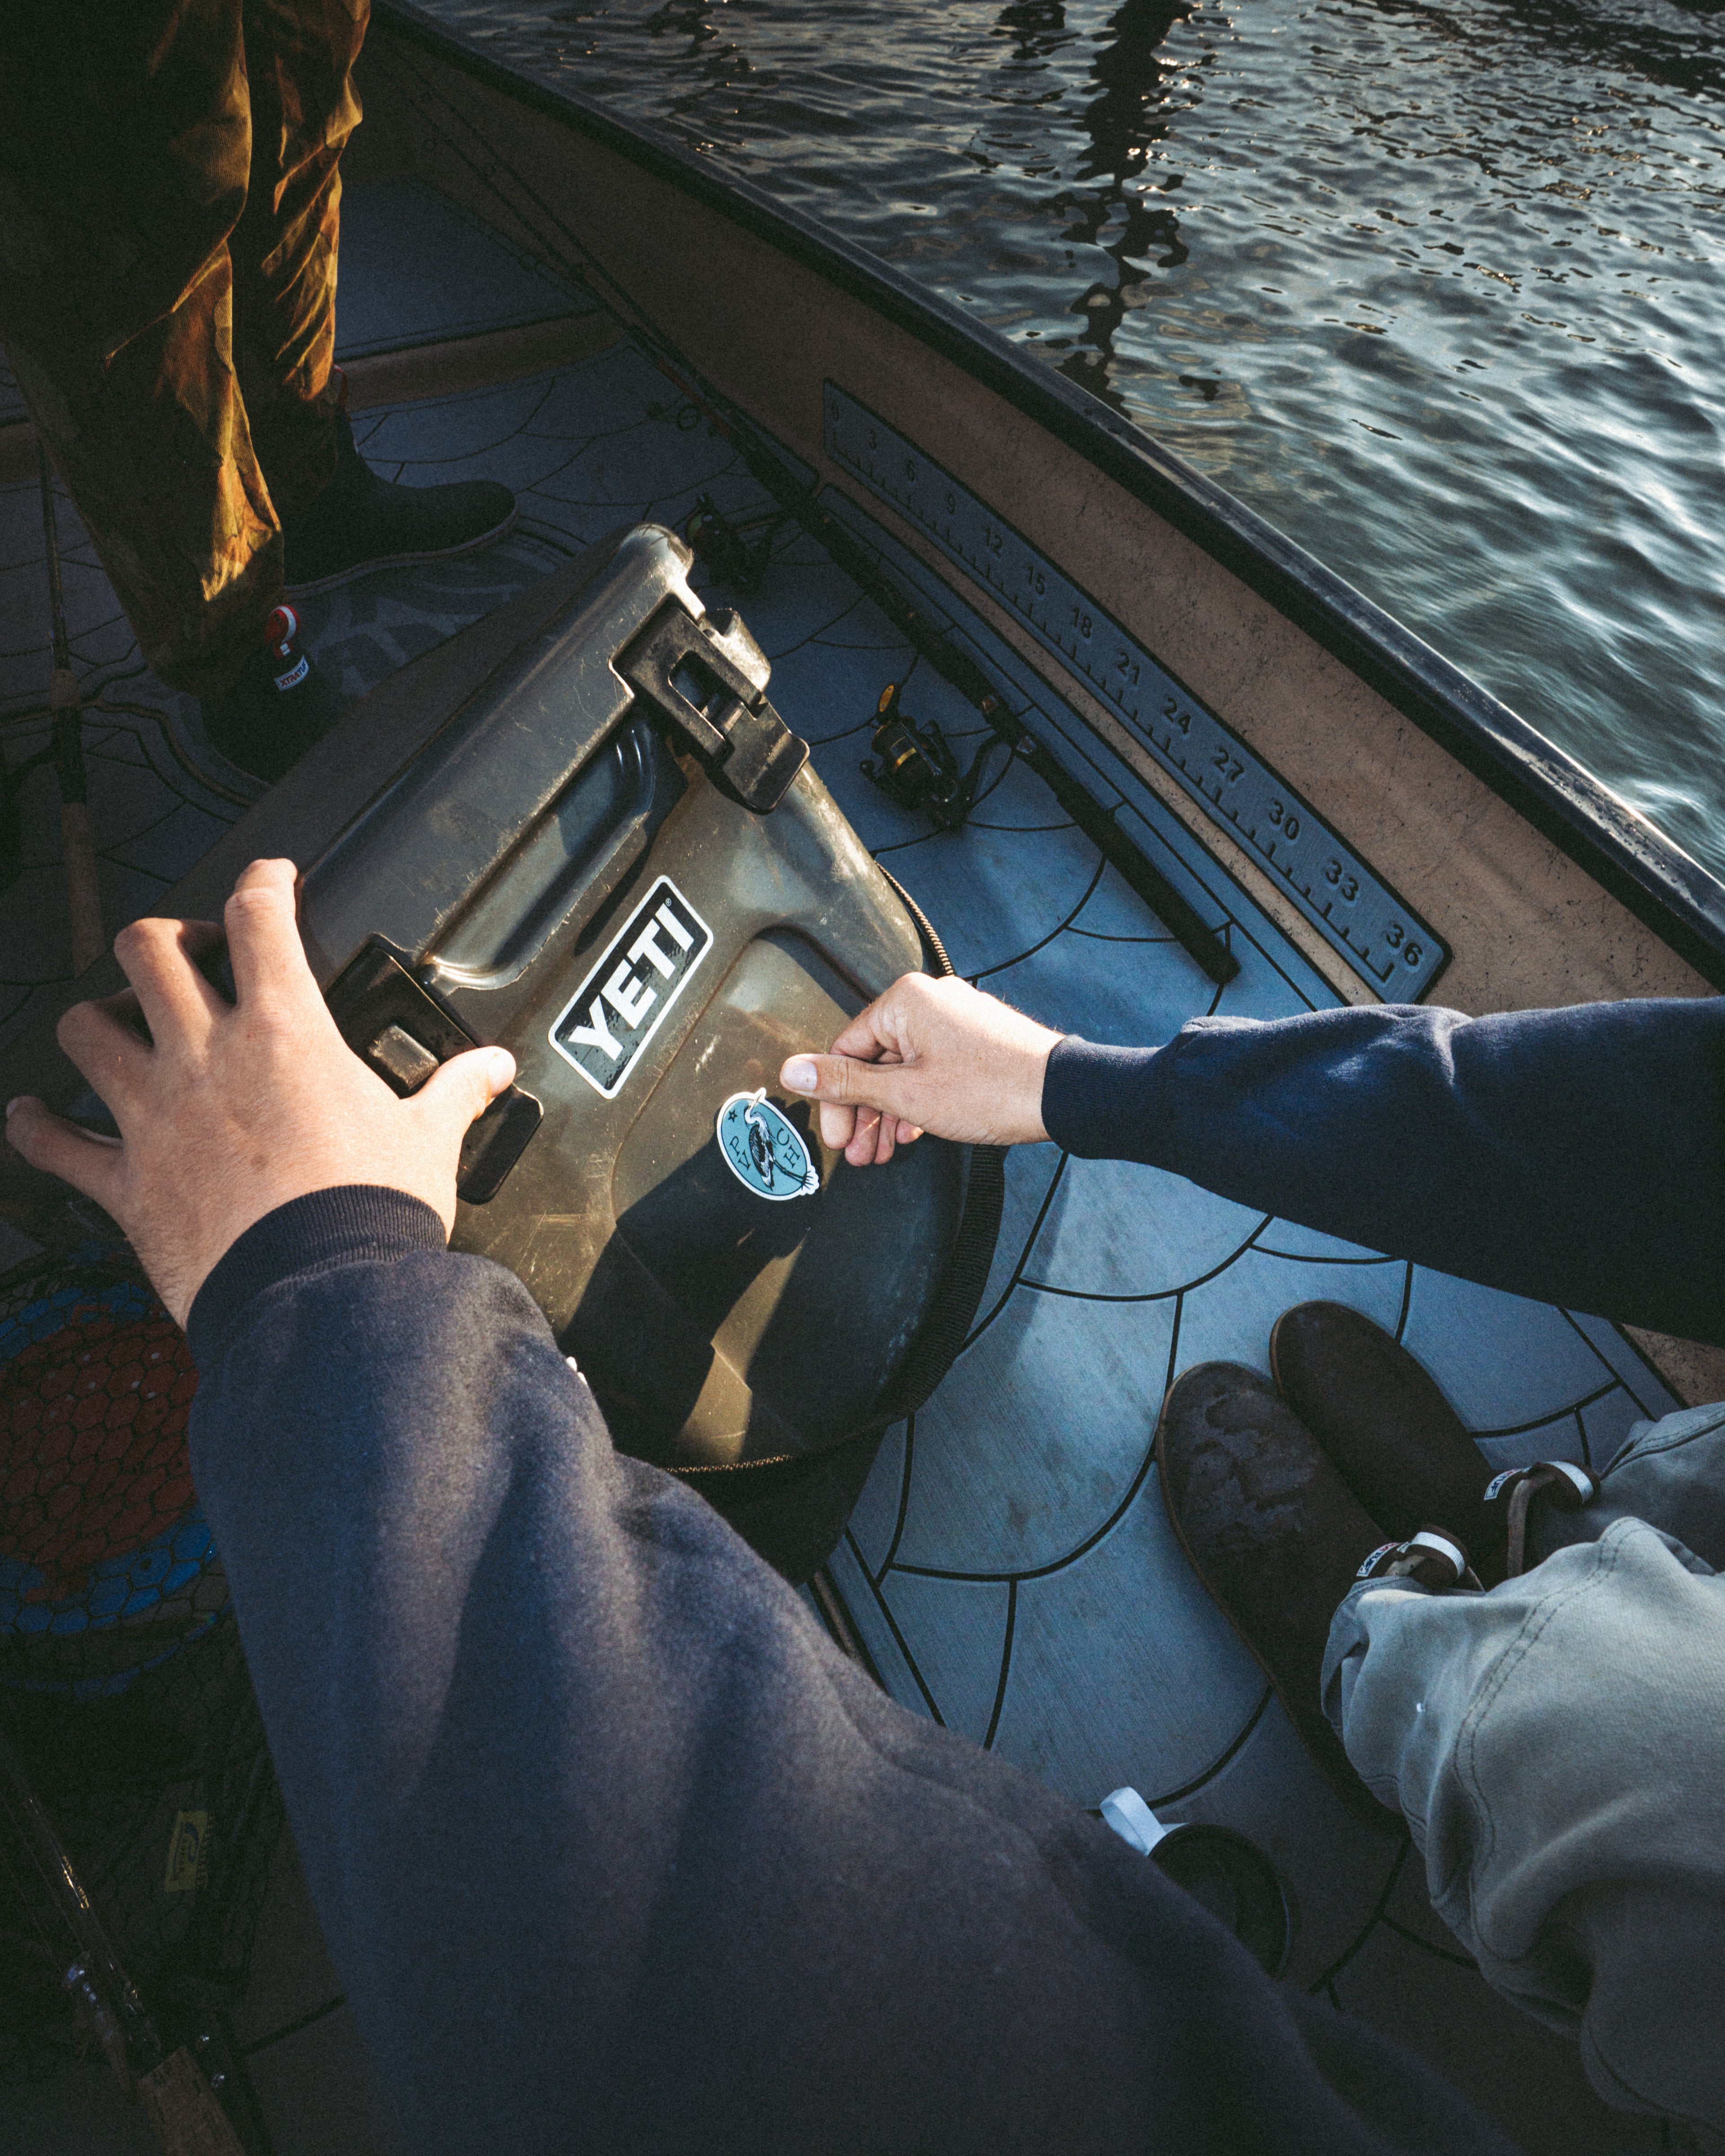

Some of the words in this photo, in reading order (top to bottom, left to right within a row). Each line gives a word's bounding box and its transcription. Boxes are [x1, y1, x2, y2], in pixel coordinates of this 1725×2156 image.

[279, 662, 306, 687] XTRATUF
[869, 429, 877, 450] 3
[907, 459, 915, 482] 6
[947, 493, 956, 514] 9
[985, 527, 1003, 558] 12
[1026, 566, 1045, 596] 15
[1071, 607, 1092, 639] 18
[1115, 652, 1140, 685] 21
[1163, 697, 1191, 734] 24
[1213, 748, 1245, 782] 27
[1269, 802, 1299, 840] 30
[1326, 861, 1359, 901] 33
[1386, 924, 1423, 966] 36
[568, 903, 694, 1061] YETI
